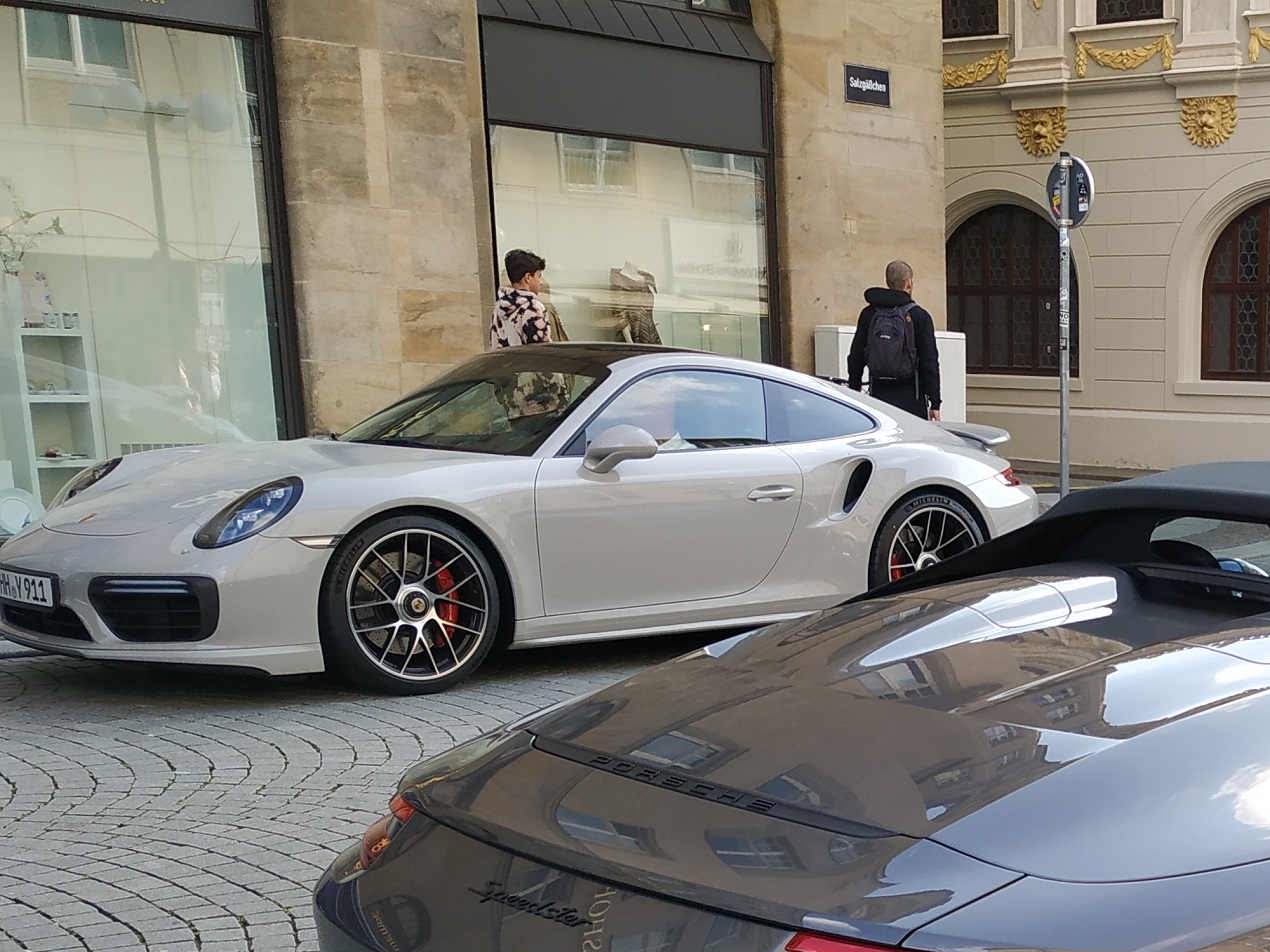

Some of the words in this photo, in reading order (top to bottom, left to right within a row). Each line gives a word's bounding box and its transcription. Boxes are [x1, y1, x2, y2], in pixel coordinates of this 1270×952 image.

[850, 76, 887, 92] Salzgäßchen
[14, 576, 21, 599] Y
[24, 577, 47, 603] 911
[589, 755, 777, 812] PORSCHE
[467, 881, 593, 928] Speedster
